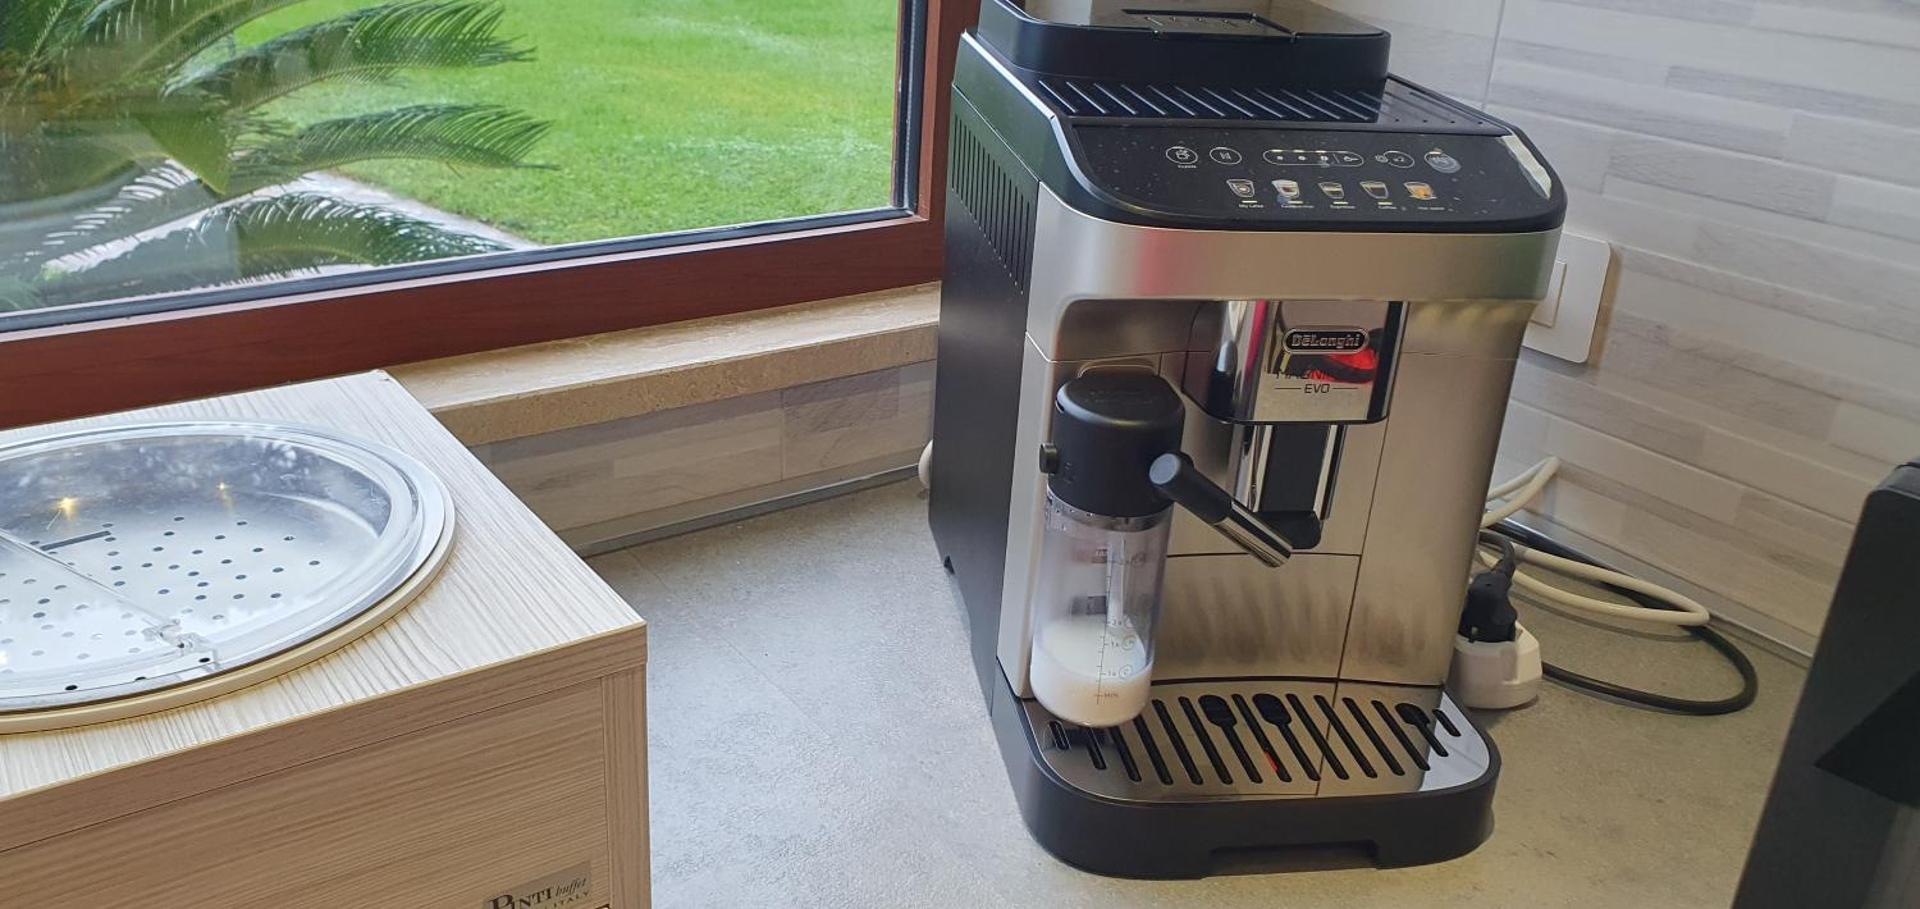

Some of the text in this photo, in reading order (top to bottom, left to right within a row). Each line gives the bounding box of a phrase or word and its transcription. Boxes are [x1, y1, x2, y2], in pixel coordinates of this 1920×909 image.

[1304, 383, 1331, 394] EVO
[490, 878, 587, 909] PINTI buffet
